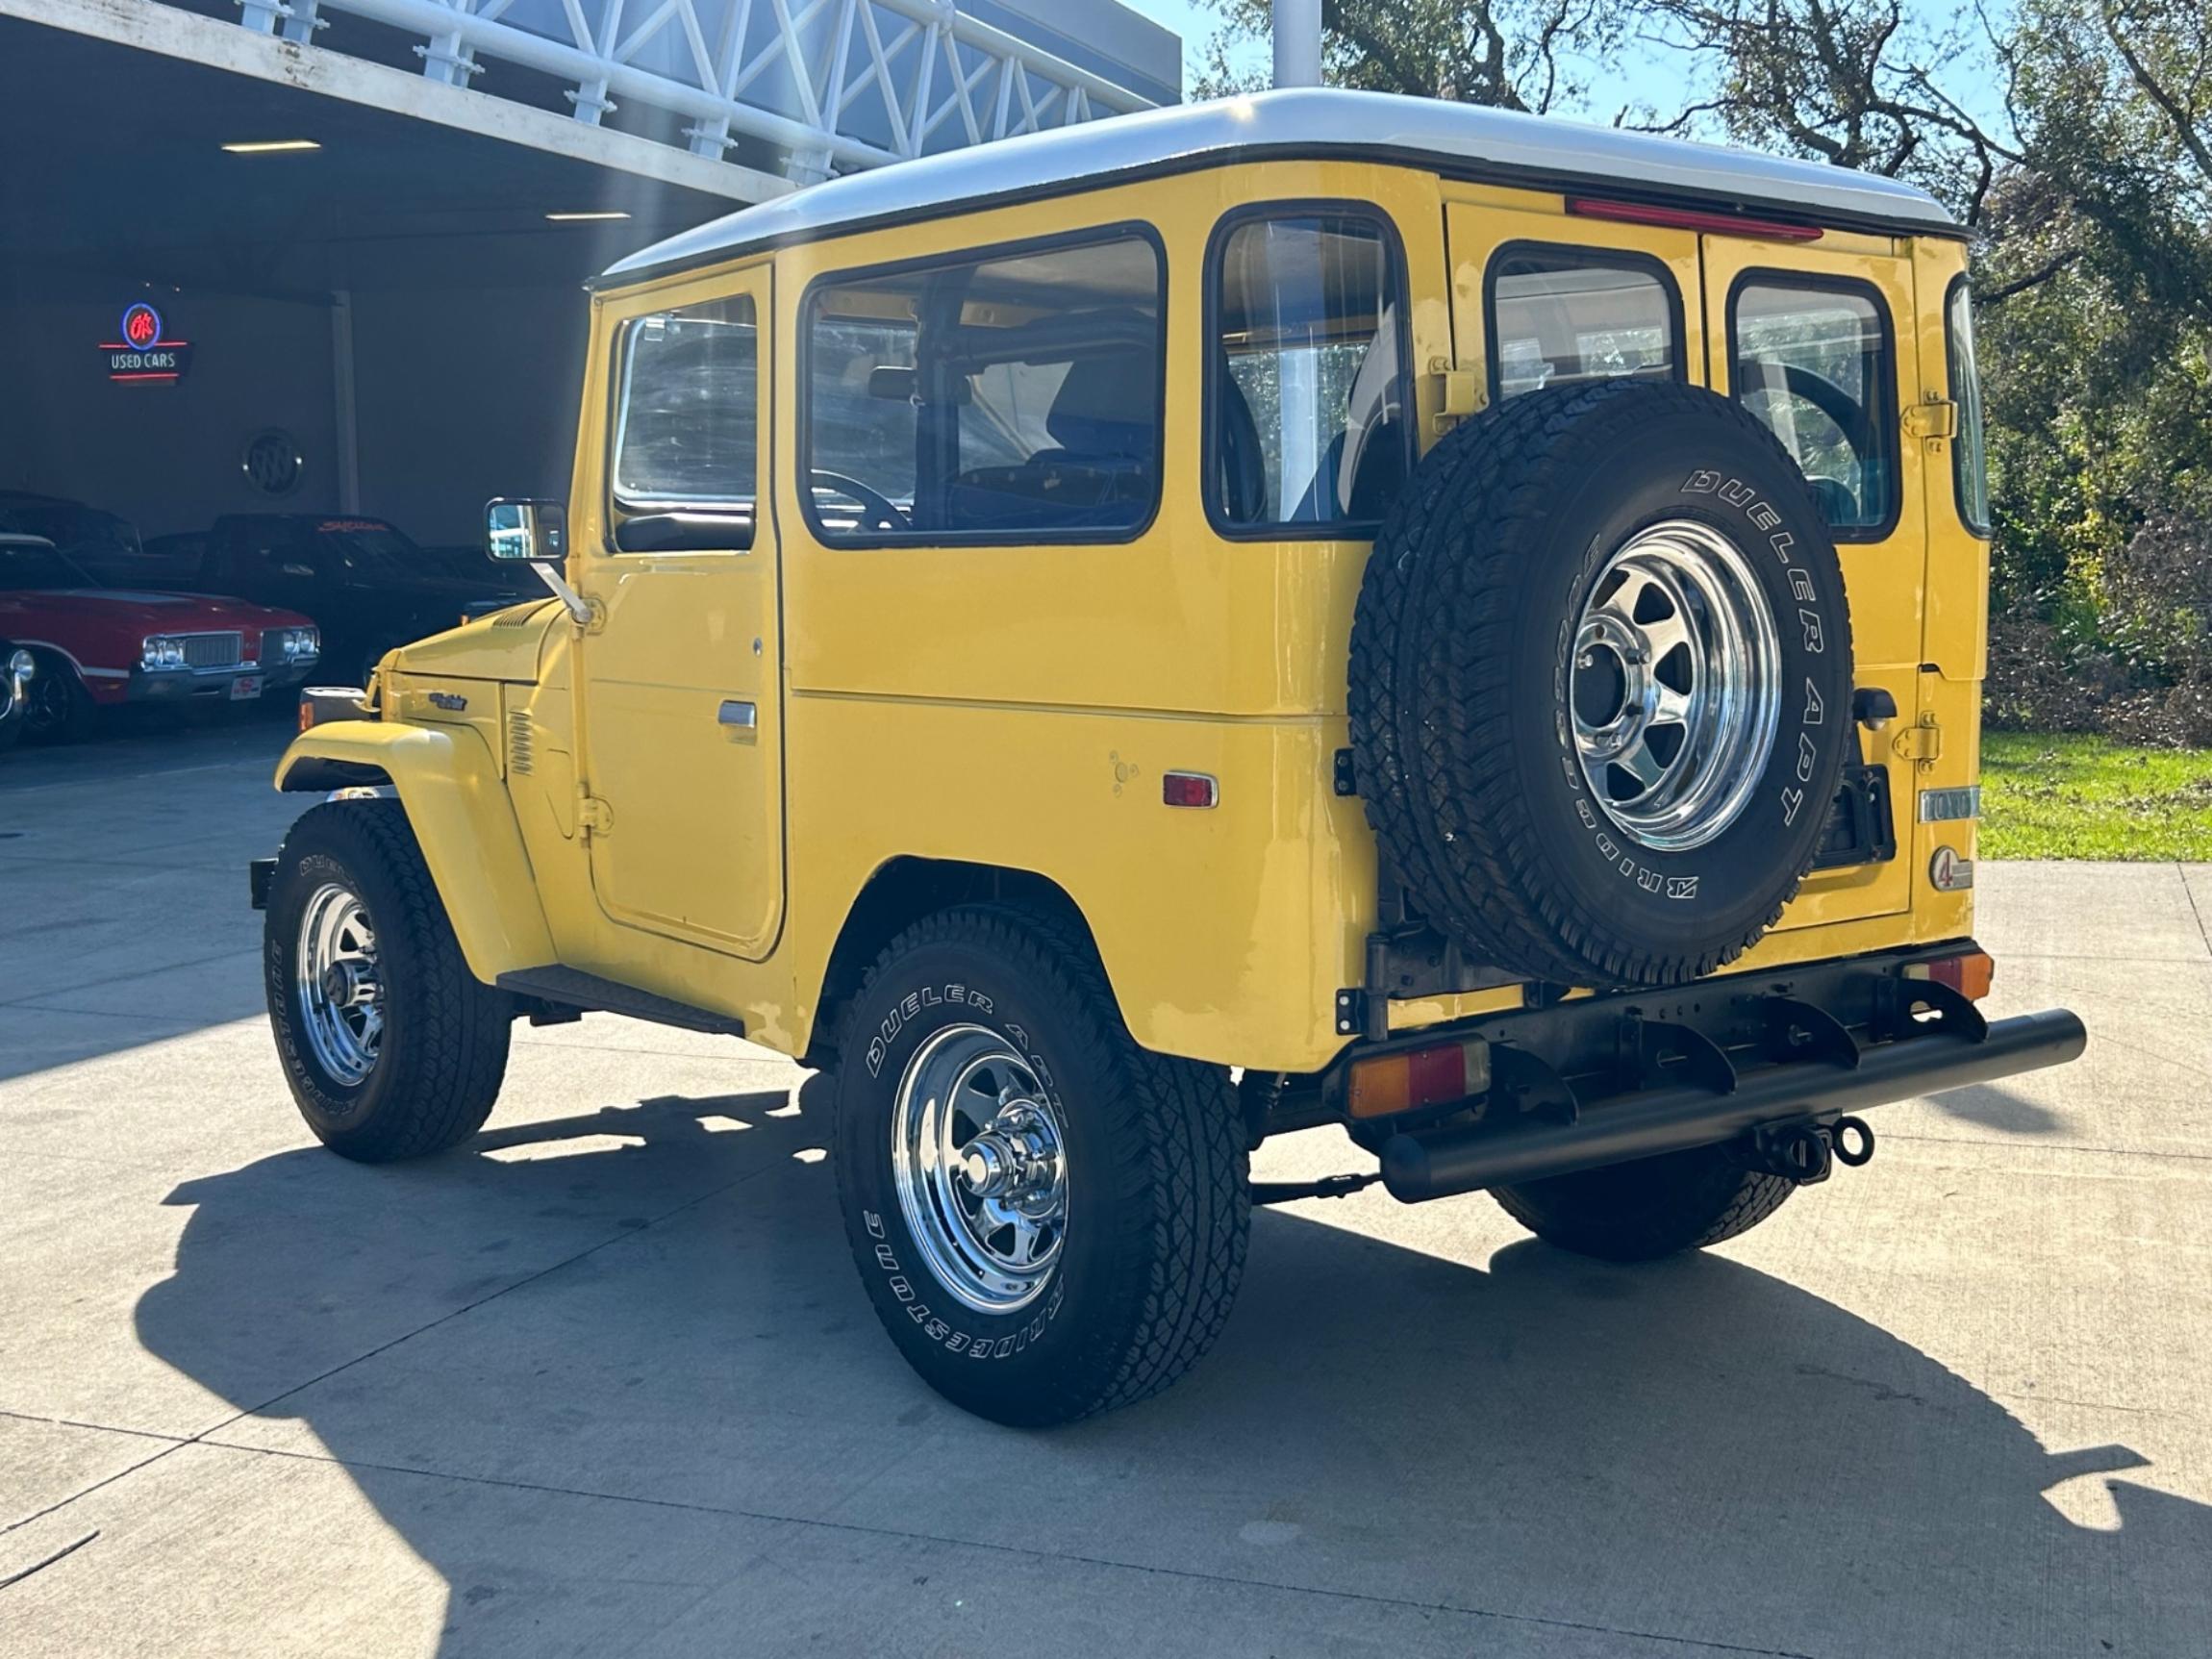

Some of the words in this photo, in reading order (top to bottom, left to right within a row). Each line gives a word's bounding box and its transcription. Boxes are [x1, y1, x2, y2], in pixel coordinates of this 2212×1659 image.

[130, 312, 153, 339] OK
[111, 353, 141, 369] USED
[143, 352, 175, 368] CARS
[1680, 469, 1824, 655] DUELER
[1782, 677, 1824, 827] APT
[1923, 789, 1980, 821] TOYO
[867, 984, 993, 1079] DUELER
[863, 1209, 1066, 1359] BRIDGESTONE
